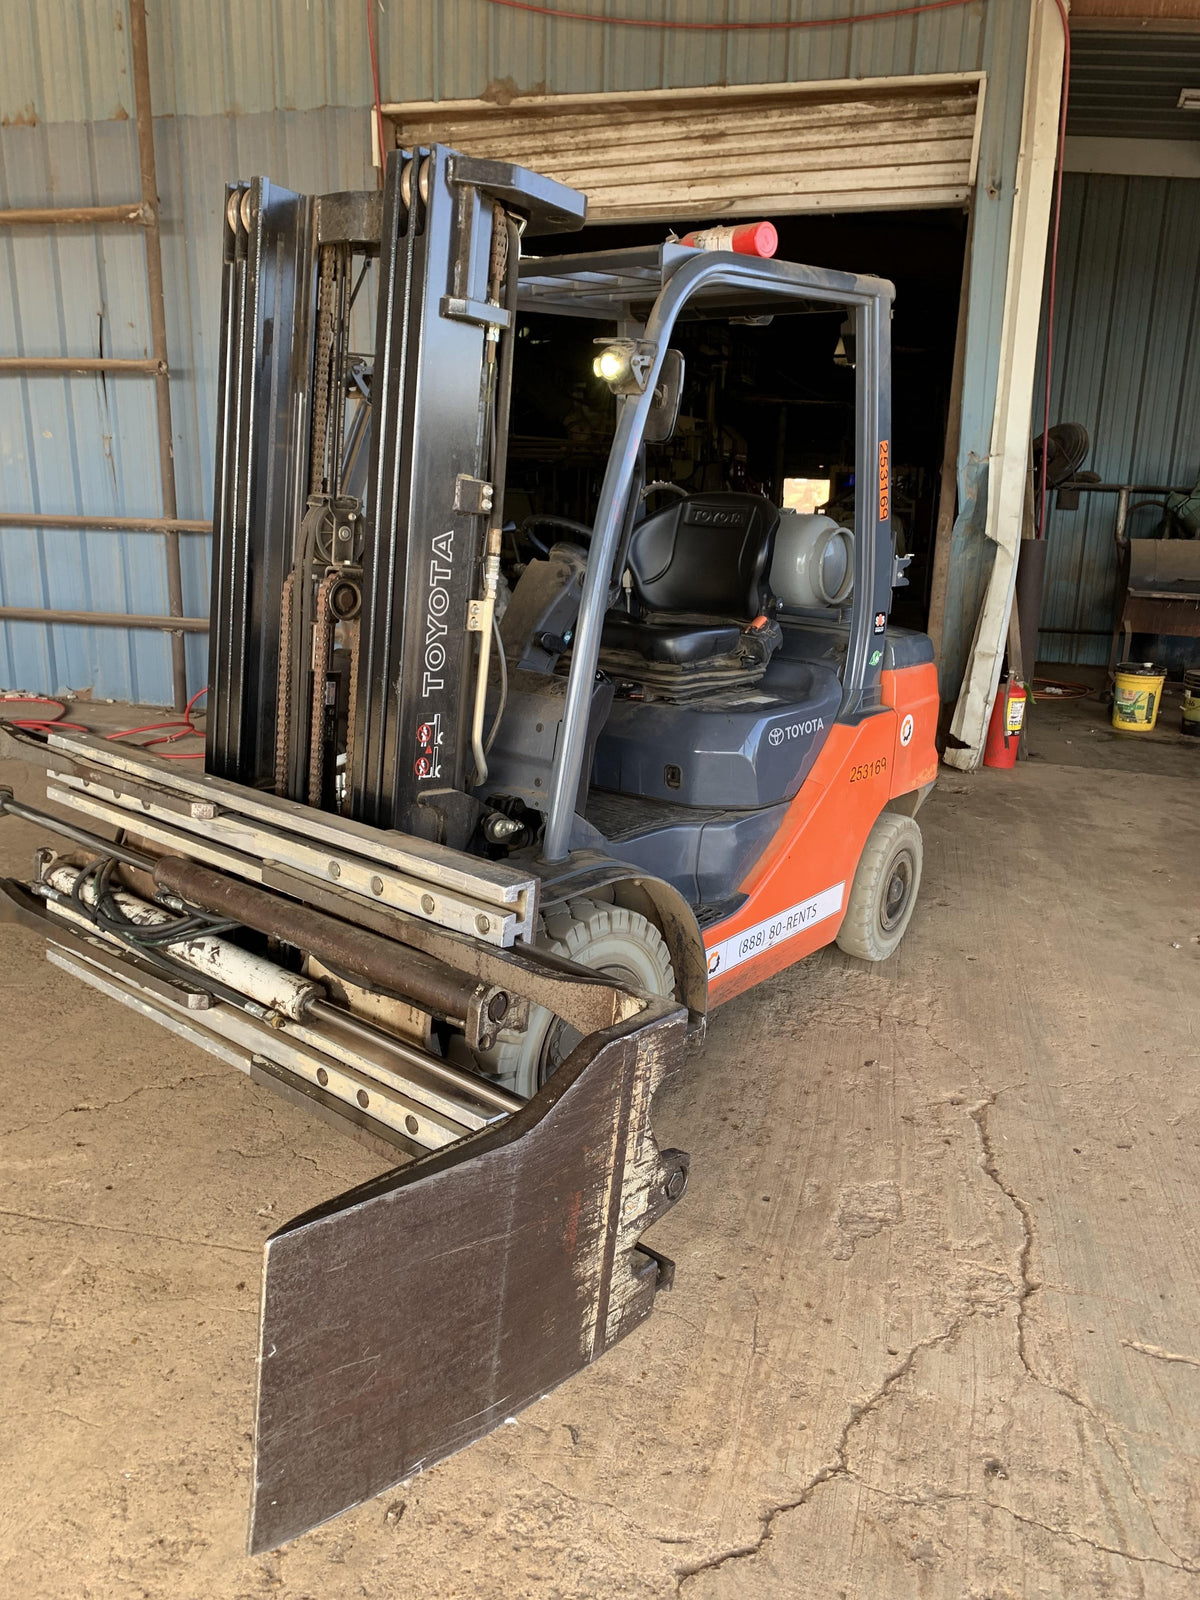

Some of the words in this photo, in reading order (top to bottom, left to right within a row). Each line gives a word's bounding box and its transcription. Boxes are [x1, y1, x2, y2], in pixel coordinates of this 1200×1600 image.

[879, 442, 889, 521] 253169
[694, 510, 742, 524] TOYOTA
[422, 530, 454, 698] TOYOTA
[785, 717, 824, 740] TOYOTA
[849, 757, 887, 783] 253169
[738, 929, 766, 958] (888)
[769, 903, 818, 940] 80-RENTS
